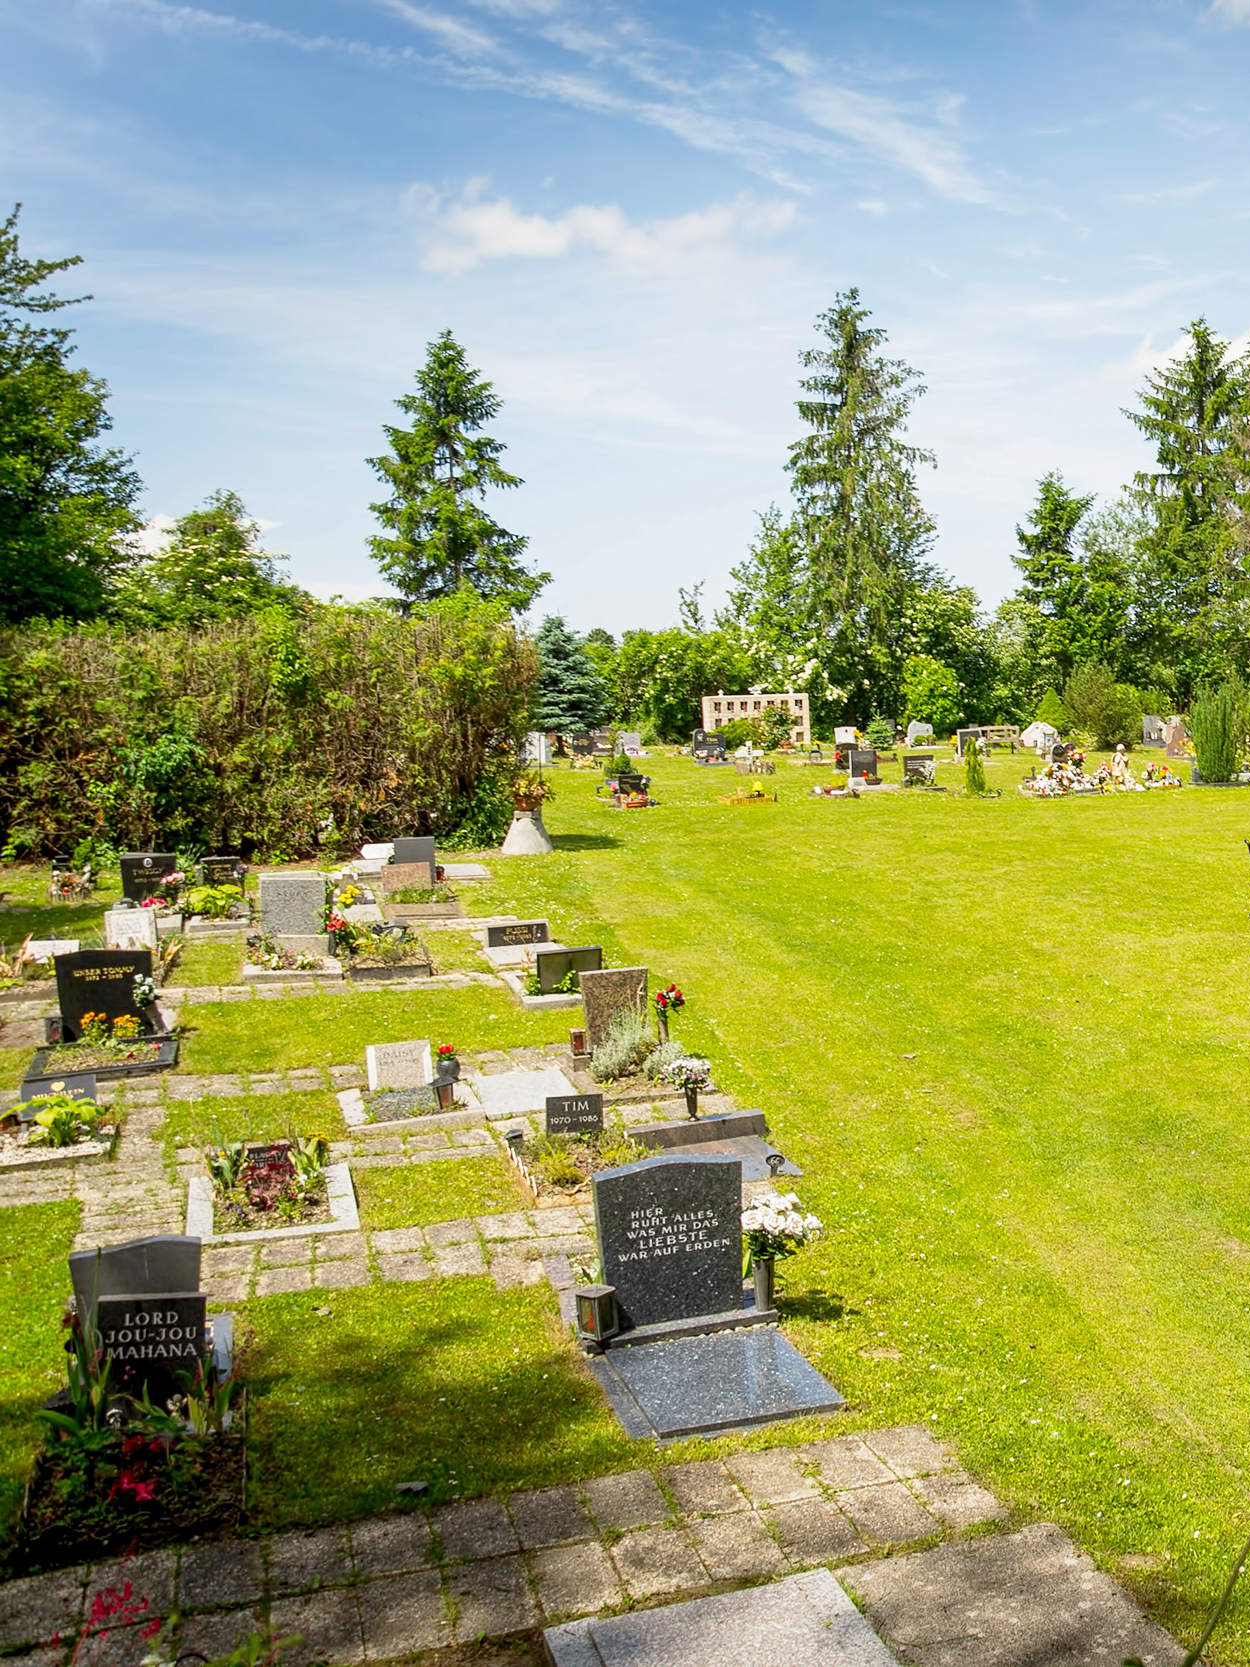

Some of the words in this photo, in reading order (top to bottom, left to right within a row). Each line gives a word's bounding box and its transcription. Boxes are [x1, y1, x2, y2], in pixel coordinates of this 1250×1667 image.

[562, 1100, 589, 1112] TIM
[550, 1116, 571, 1125] 1970
[579, 1115, 598, 1123] 1986
[630, 1207, 664, 1219] HIER
[631, 1216, 668, 1229] RUHT
[673, 1209, 714, 1223] ALLES
[626, 1228, 656, 1239] WAS
[661, 1223, 687, 1234] MIR
[692, 1218, 719, 1230] DAS
[640, 1230, 708, 1249] LIEBSTE
[618, 1251, 648, 1262] WAR
[653, 1245, 680, 1257] AUF
[685, 1237, 730, 1252] ERDEN
[124, 1311, 179, 1326] LORD
[105, 1326, 197, 1344] JOU-JOU
[105, 1343, 198, 1360] MAHANA
